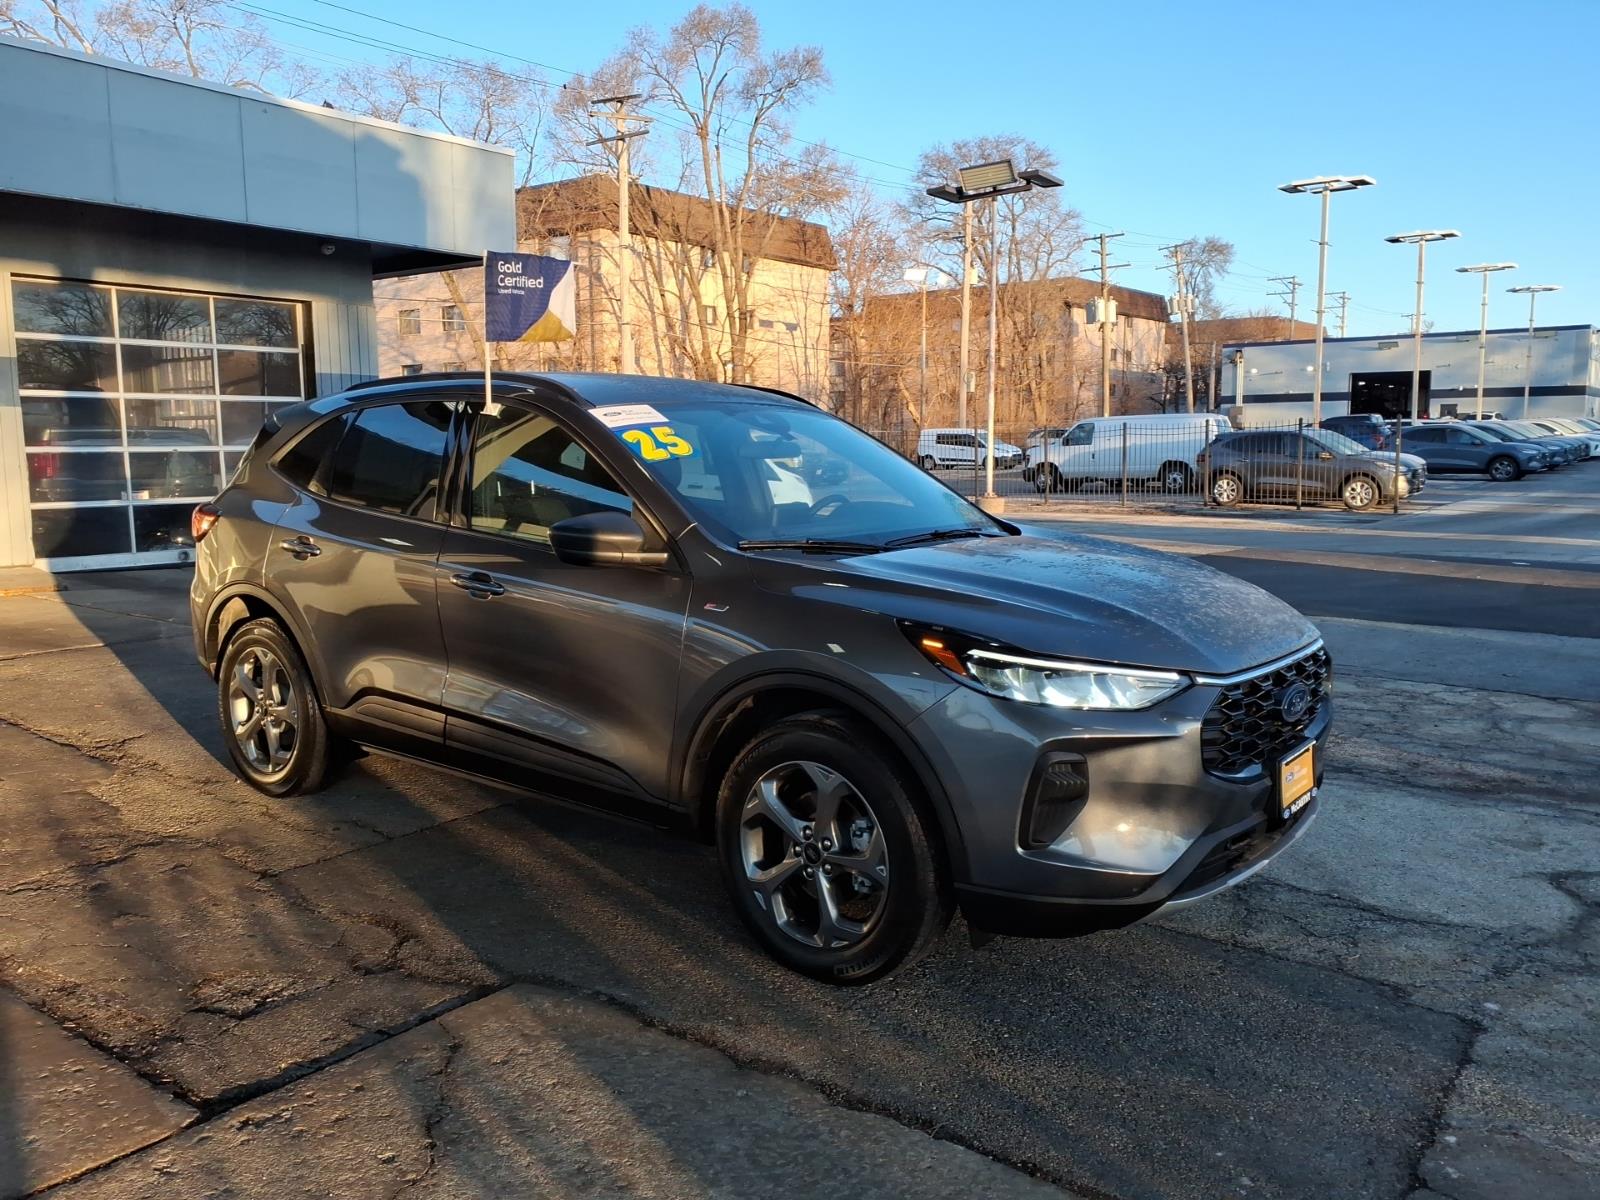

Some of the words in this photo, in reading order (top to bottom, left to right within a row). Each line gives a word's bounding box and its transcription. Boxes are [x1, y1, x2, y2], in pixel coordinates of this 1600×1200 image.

[498, 261, 522, 274] Gold
[498, 275, 544, 288] Certified
[622, 426, 693, 461] 25
